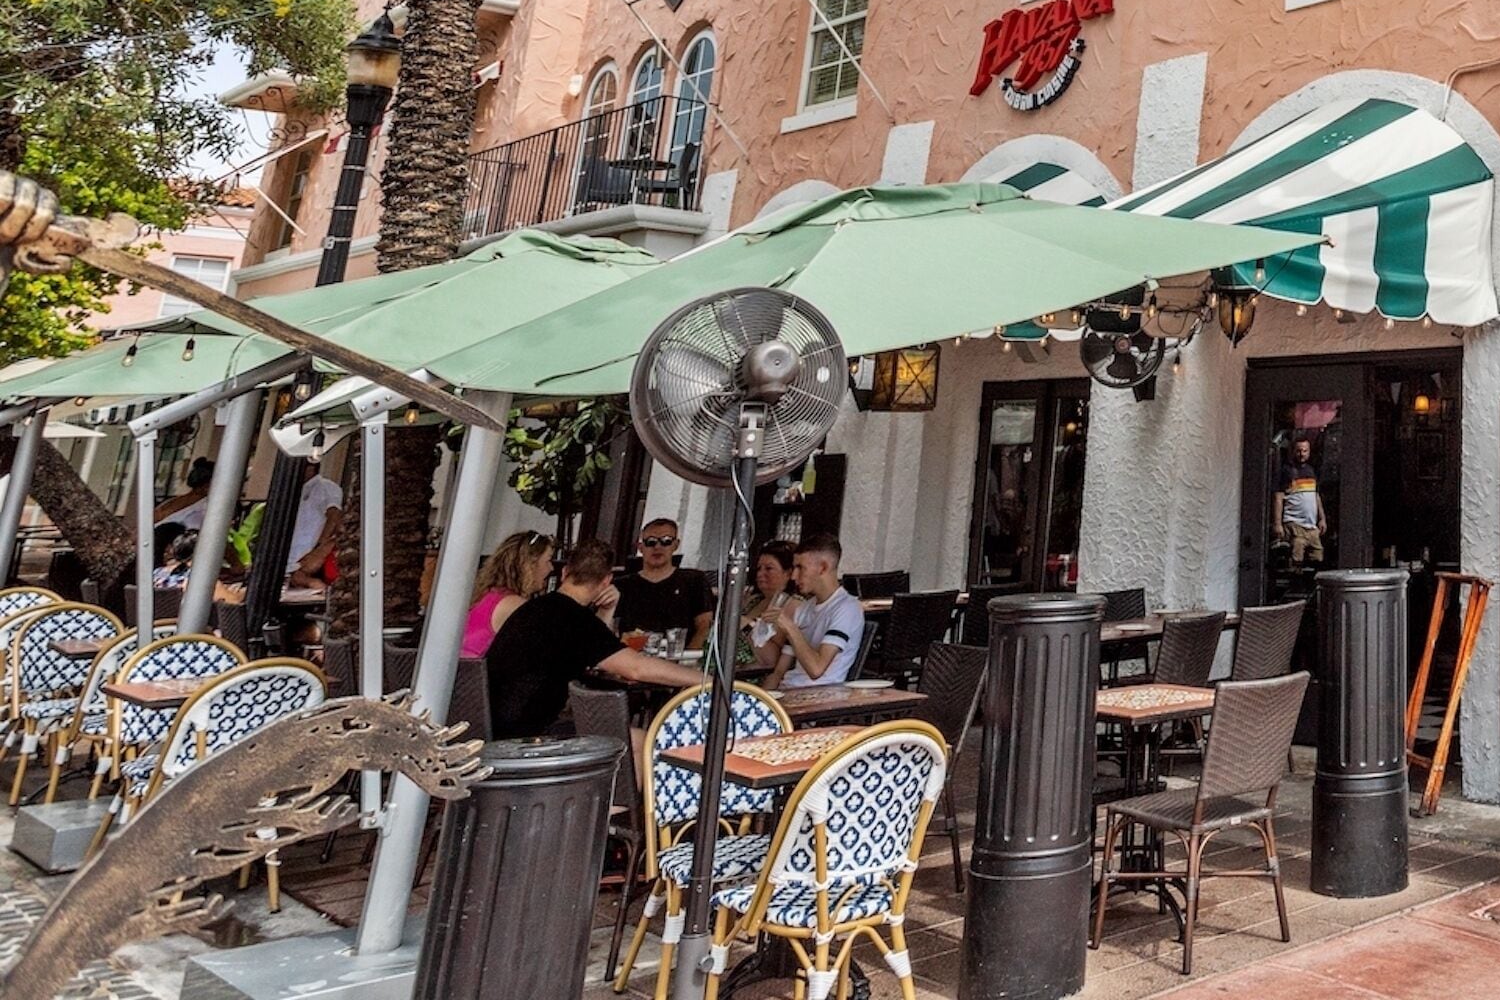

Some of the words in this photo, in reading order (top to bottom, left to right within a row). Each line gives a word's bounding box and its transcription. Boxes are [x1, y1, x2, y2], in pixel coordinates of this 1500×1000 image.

[1004, 85, 1034, 111] CUBAN
[1036, 53, 1075, 106] CUISINE
[1013, 24, 1082, 91] 1957
